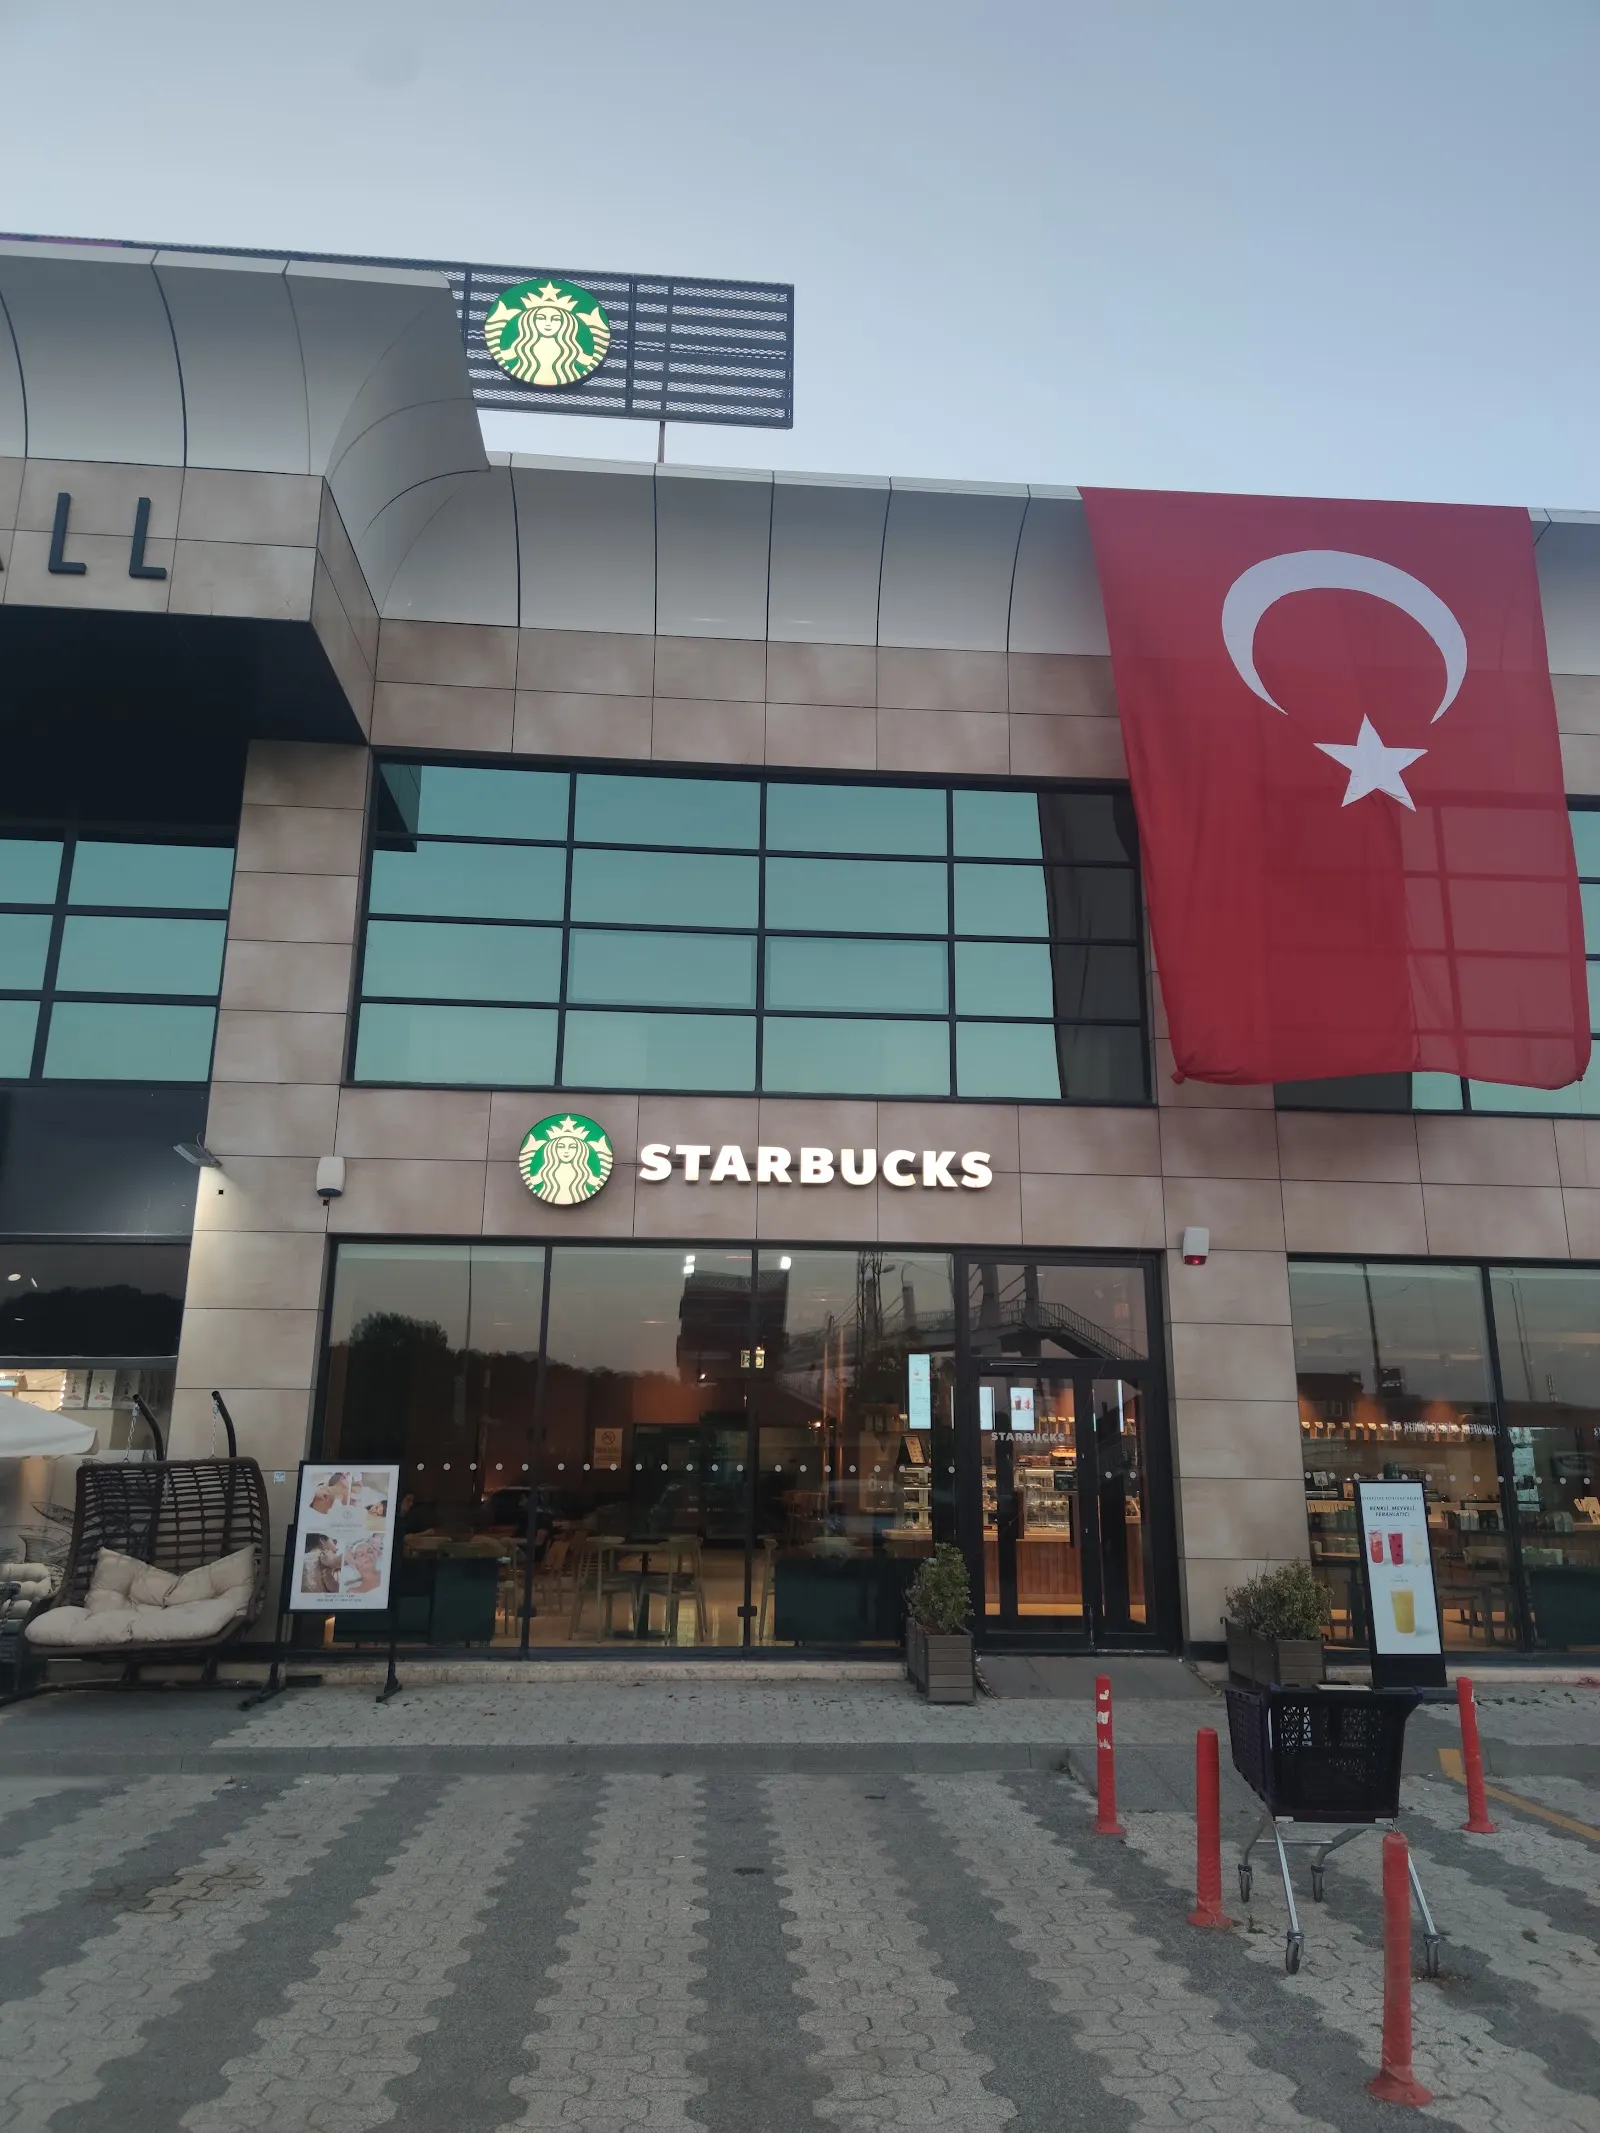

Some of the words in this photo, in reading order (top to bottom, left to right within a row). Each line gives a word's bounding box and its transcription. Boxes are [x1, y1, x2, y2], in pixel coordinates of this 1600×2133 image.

[0, 492, 168, 580] LL
[639, 1142, 993, 1189] STARBUCKS
[991, 1431, 1065, 1442] STARBUCKS
